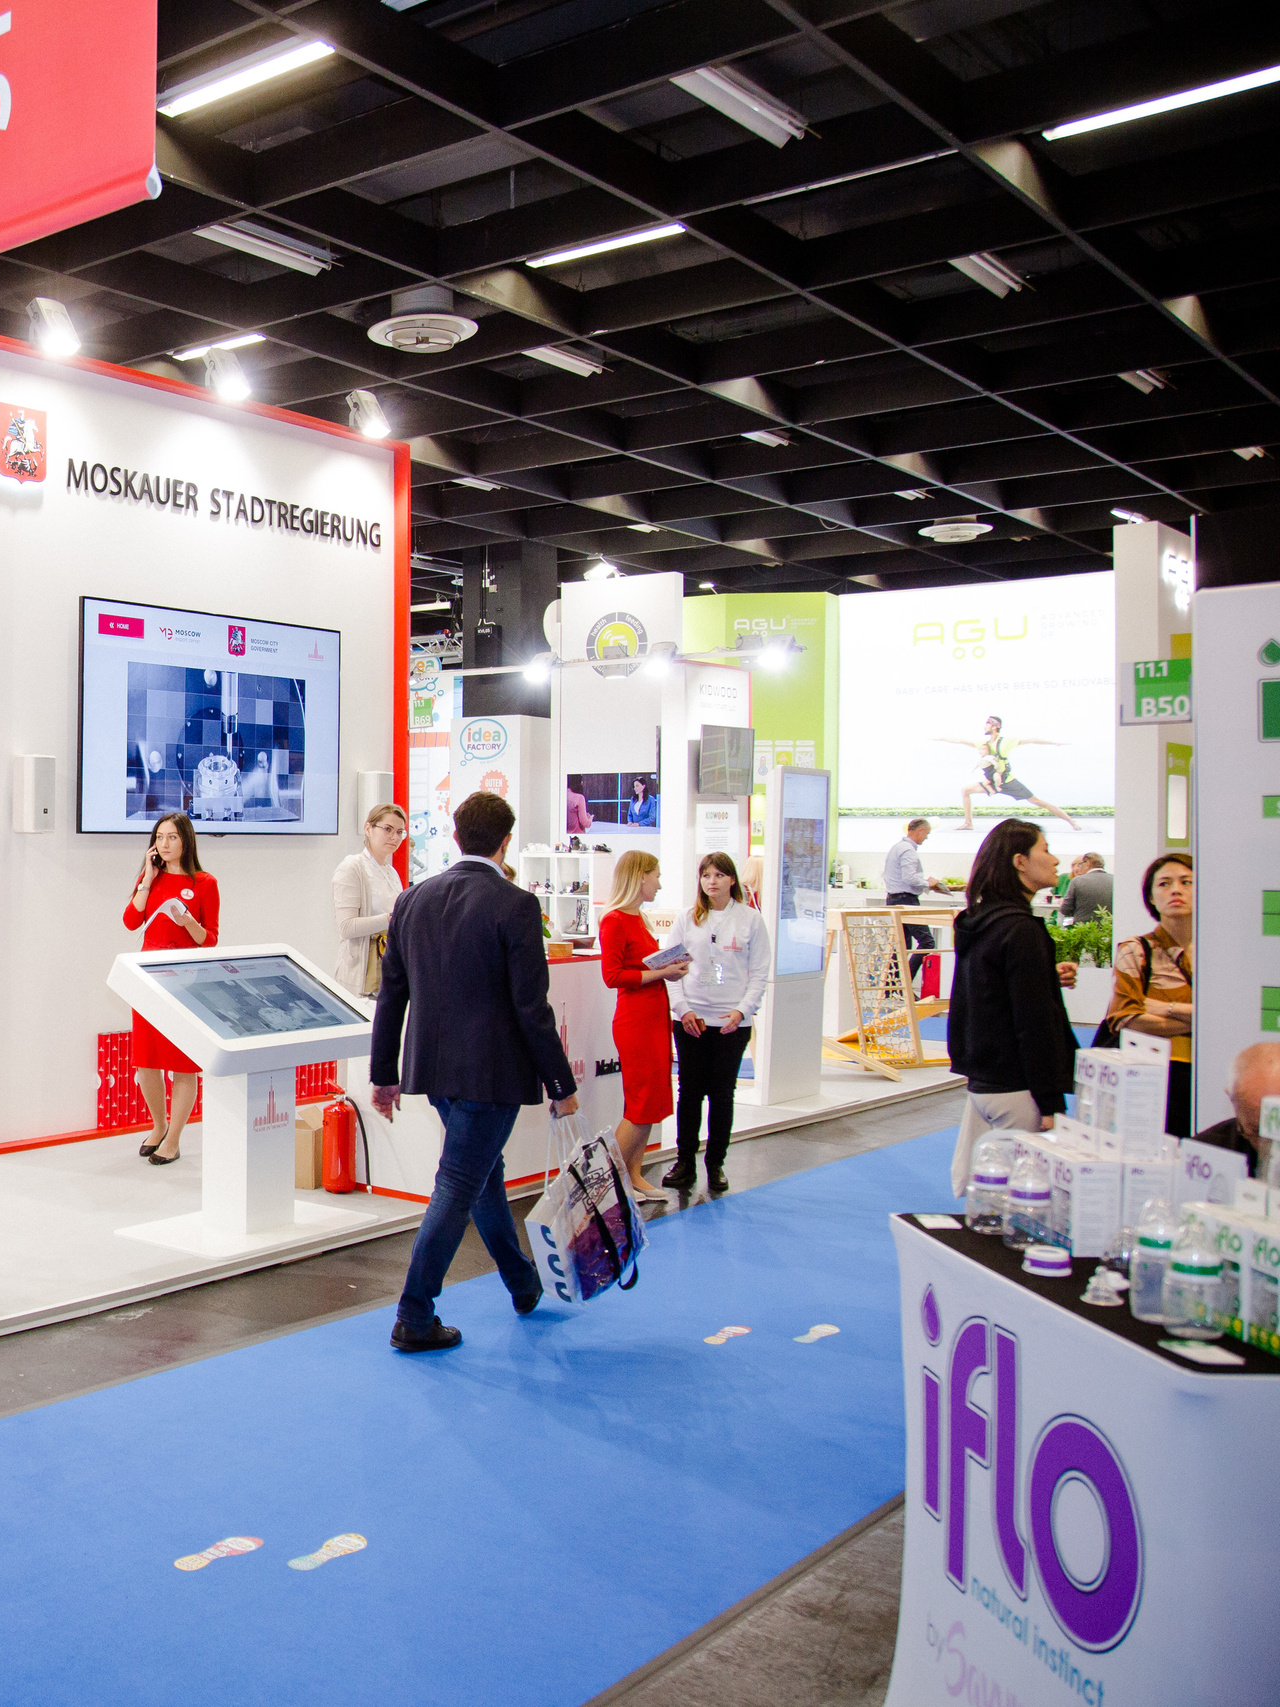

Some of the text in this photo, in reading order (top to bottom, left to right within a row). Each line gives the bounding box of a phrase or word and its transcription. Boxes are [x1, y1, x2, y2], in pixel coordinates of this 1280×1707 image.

[66, 457, 382, 548] MOSKAUER STADTREGIERUNG
[590, 619, 607, 637] health
[625, 615, 643, 635] feeding
[734, 618, 786, 631] AGU
[912, 614, 1028, 647] AGU
[175, 629, 201, 638] MOSCOW
[1136, 661, 1169, 679] 11.1
[924, 685, 950, 694] CARE
[953, 684, 974, 693] HAS
[976, 682, 1010, 692] NEVER
[1013, 681, 1040, 691] BEEN
[1044, 679, 1059, 689] SO
[414, 699, 425, 708] 11.1
[1141, 695, 1190, 718] B50
[415, 714, 431, 725] B69
[467, 727, 501, 743] idea
[467, 743, 502, 751] FACTORY
[485, 778, 503, 788] GUTEN
[656, 919, 674, 927] KID
[921, 1284, 1145, 1655] iflo
[970, 1576, 1029, 1646] natural
[1033, 1623, 1105, 1706] instinct
